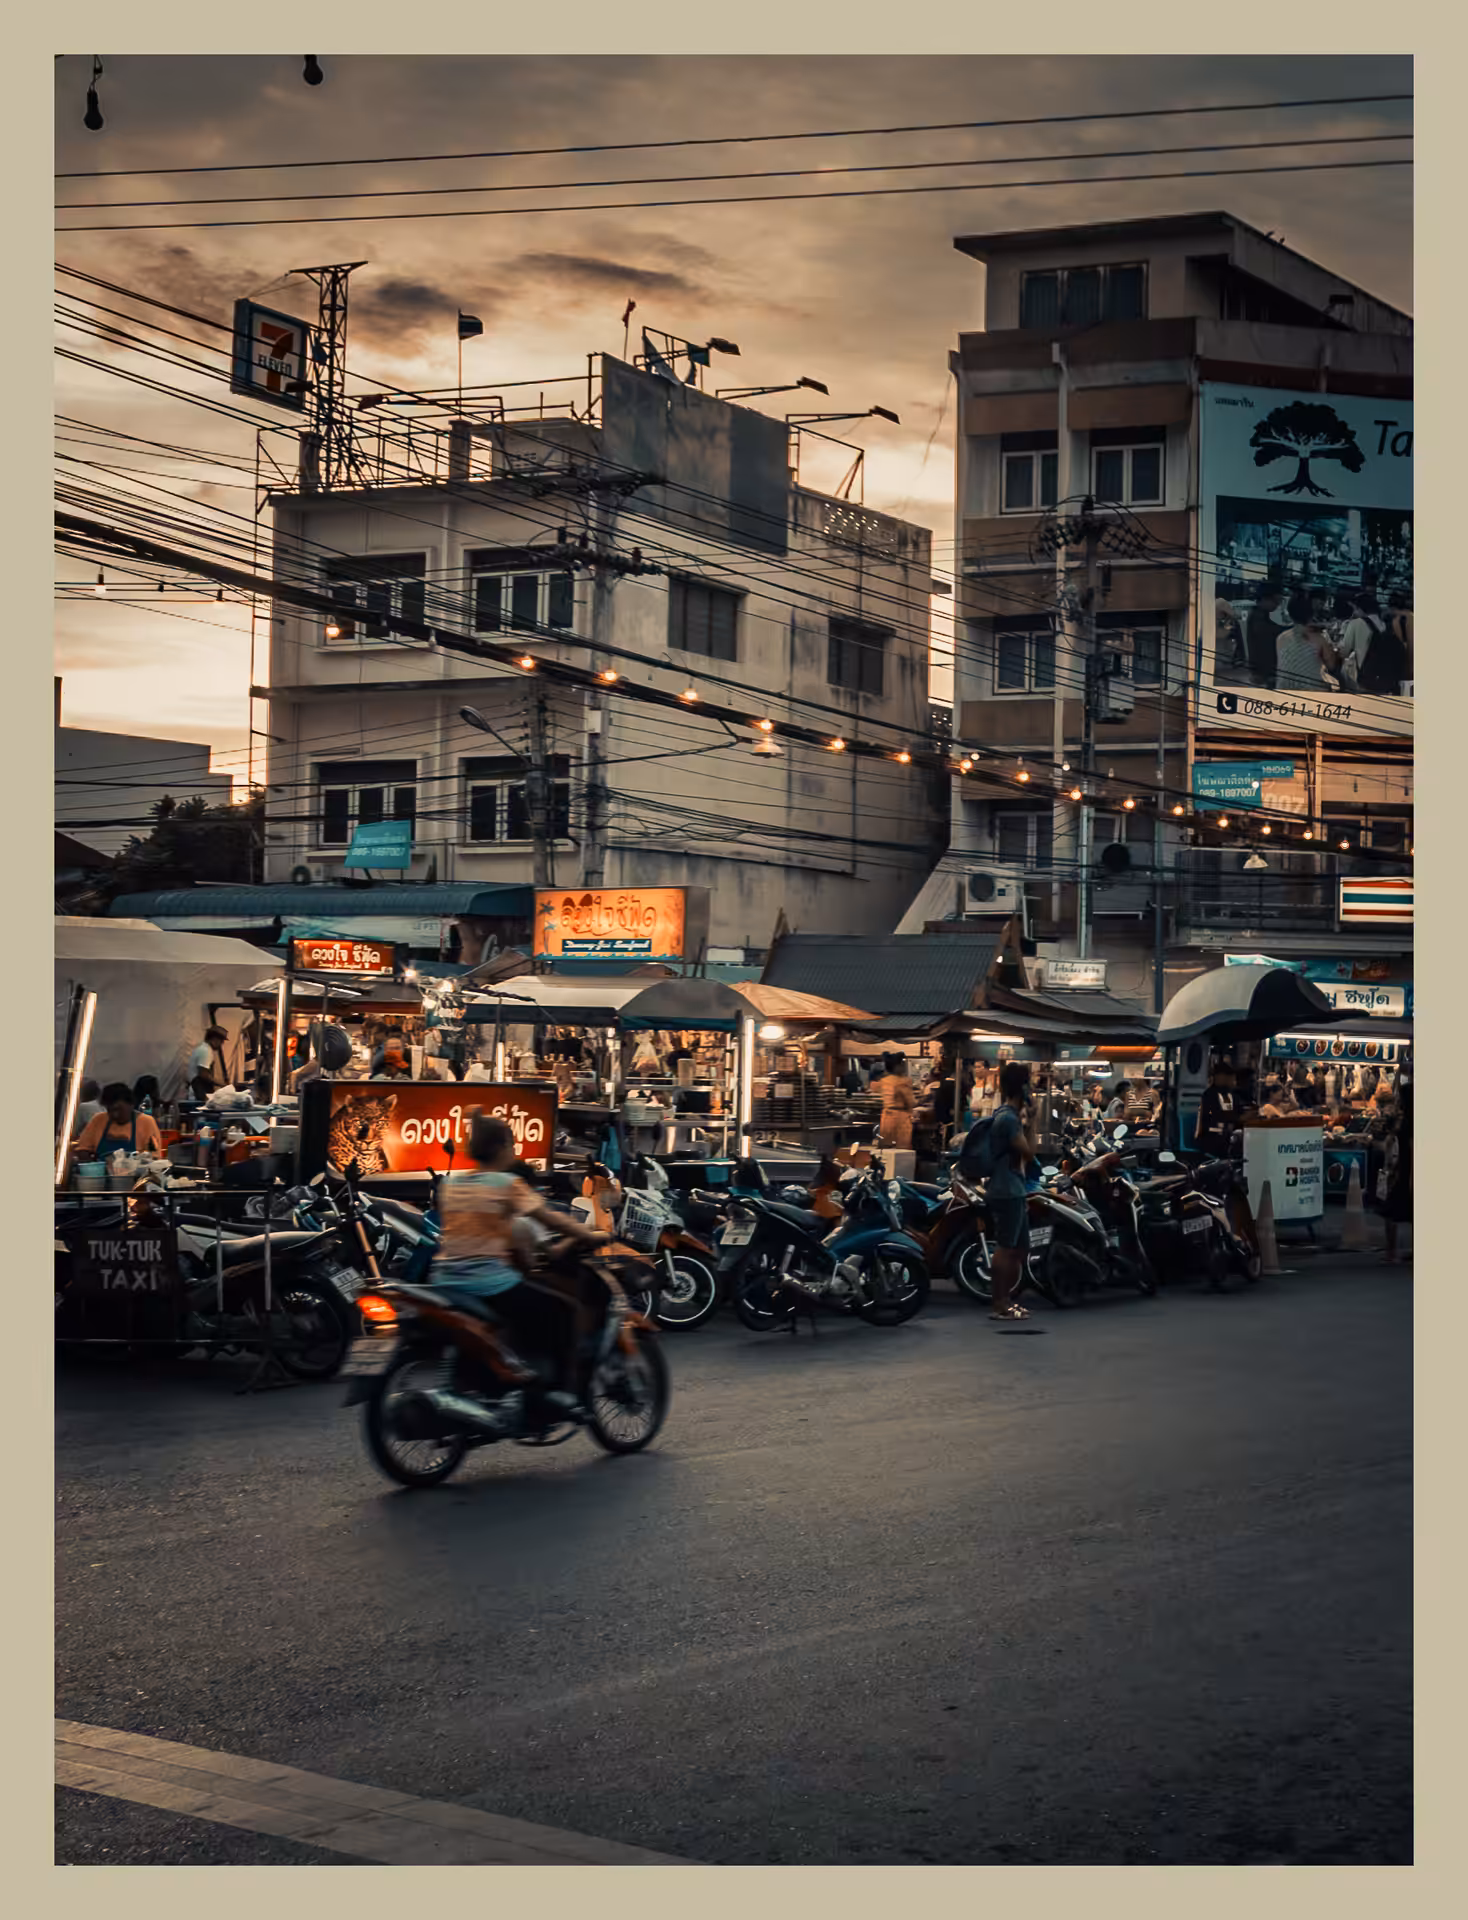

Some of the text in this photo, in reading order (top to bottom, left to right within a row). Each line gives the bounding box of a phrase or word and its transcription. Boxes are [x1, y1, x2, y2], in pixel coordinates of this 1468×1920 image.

[1244, 700, 1352, 719] 088-611-1644
[88, 1240, 162, 1261] TUK-TUK
[100, 1268, 158, 1291] TAXI
